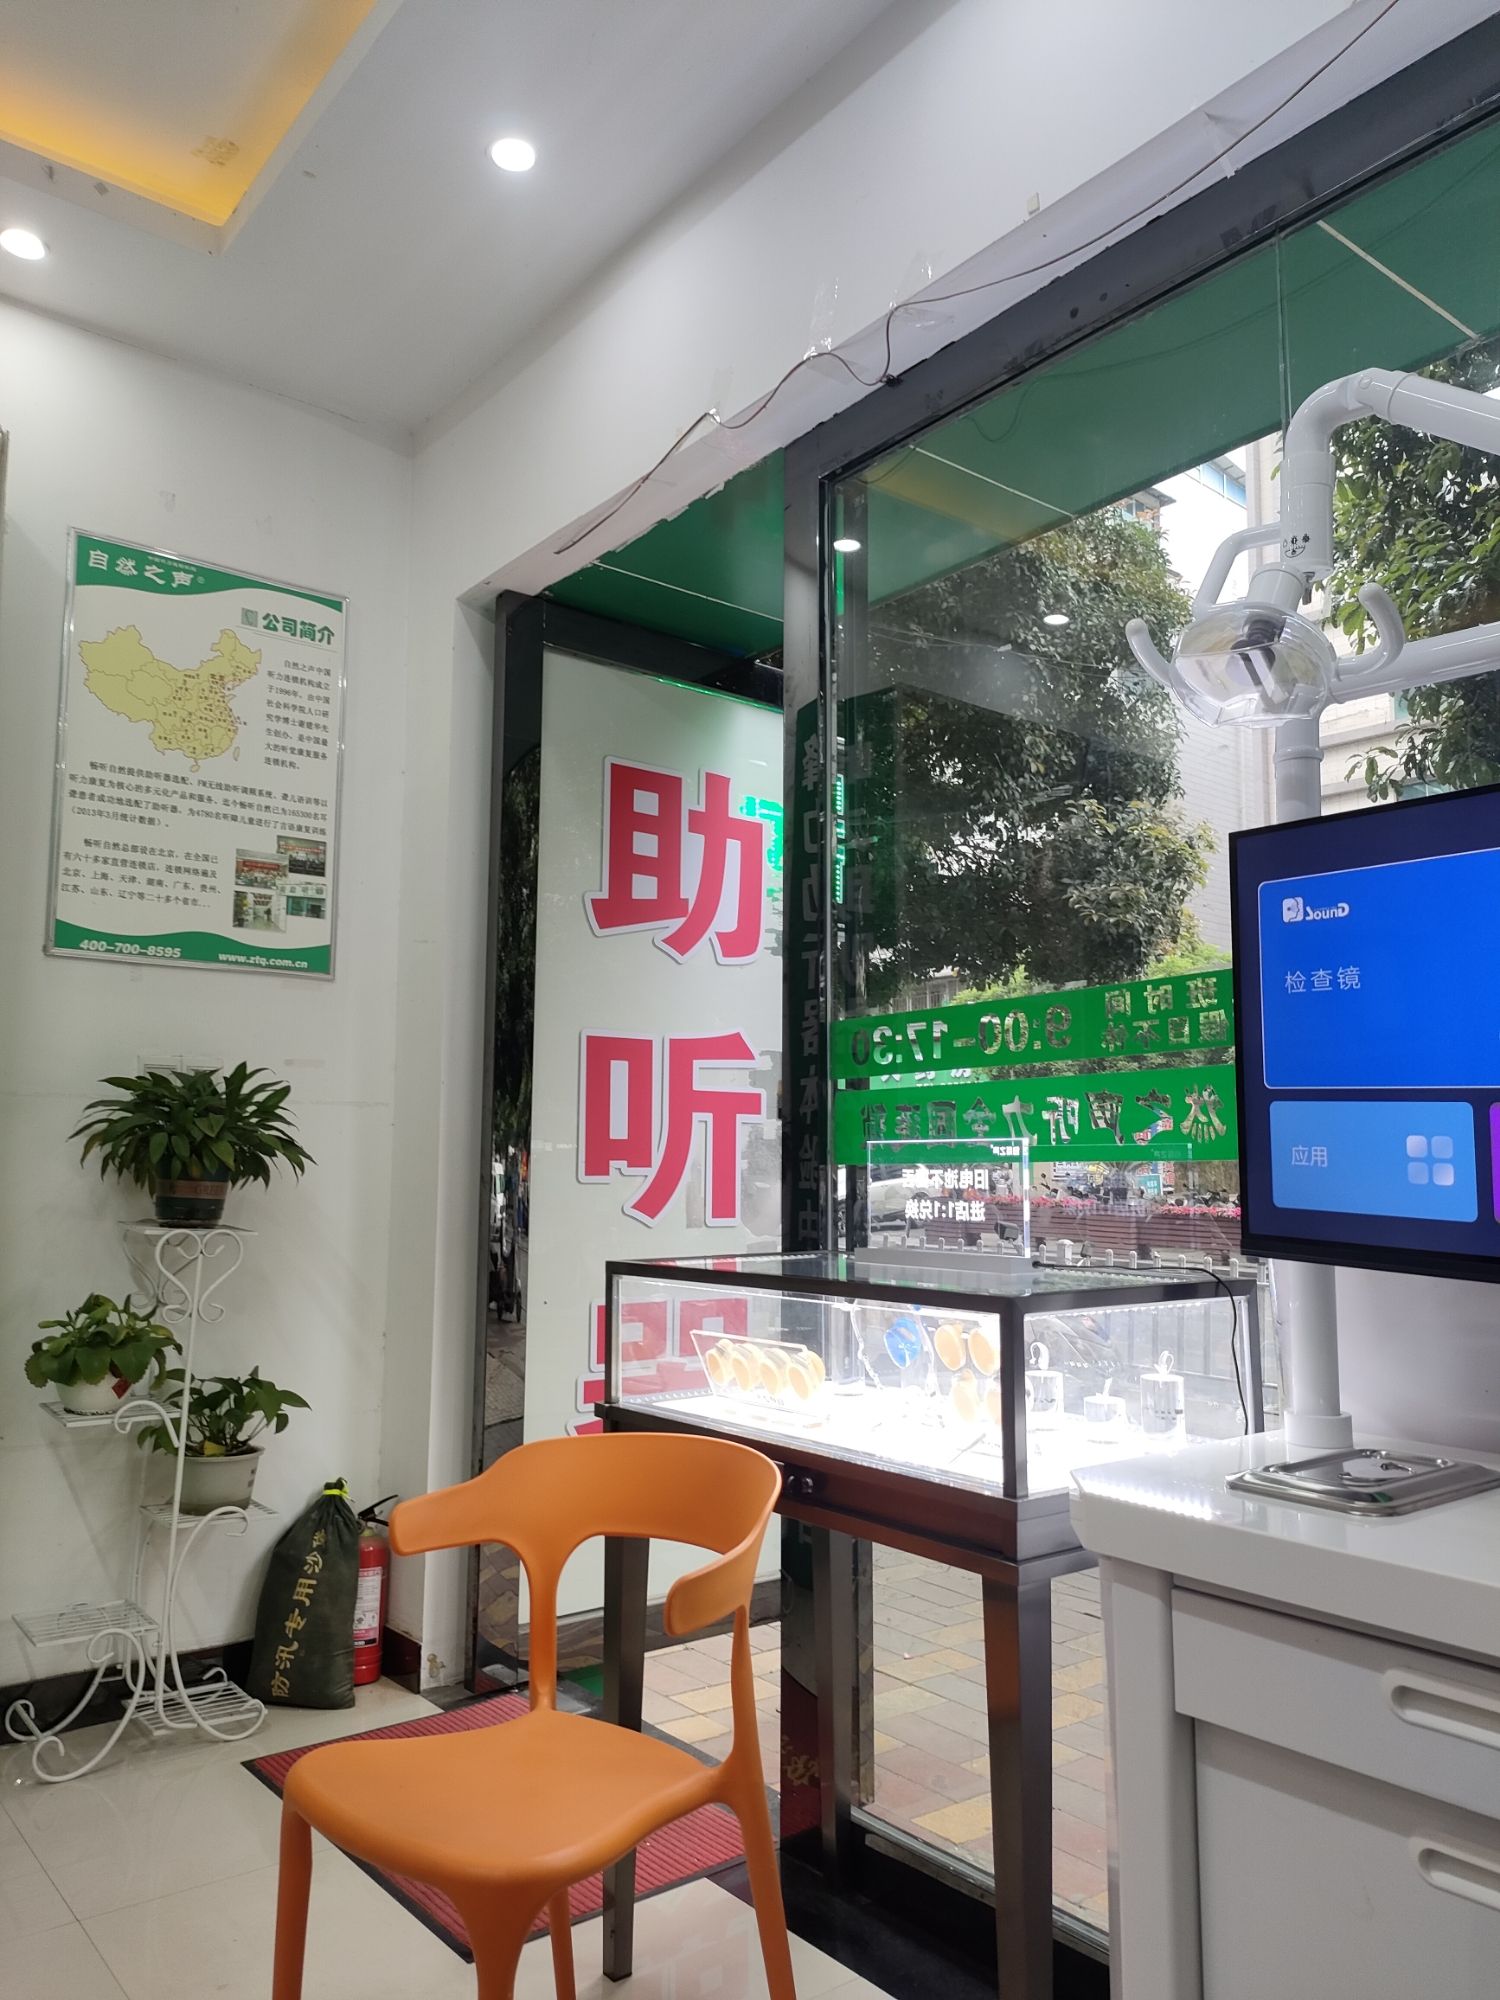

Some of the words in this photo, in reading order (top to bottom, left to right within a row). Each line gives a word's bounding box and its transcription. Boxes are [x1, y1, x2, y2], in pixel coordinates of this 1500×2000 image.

[88, 549, 194, 588] 自然之声
[261, 610, 334, 646] 公司简介
[79, 939, 181, 958] 400-700-8595
[1284, 965, 1361, 994] 检查镜
[1291, 1145, 1329, 1168] 应用
